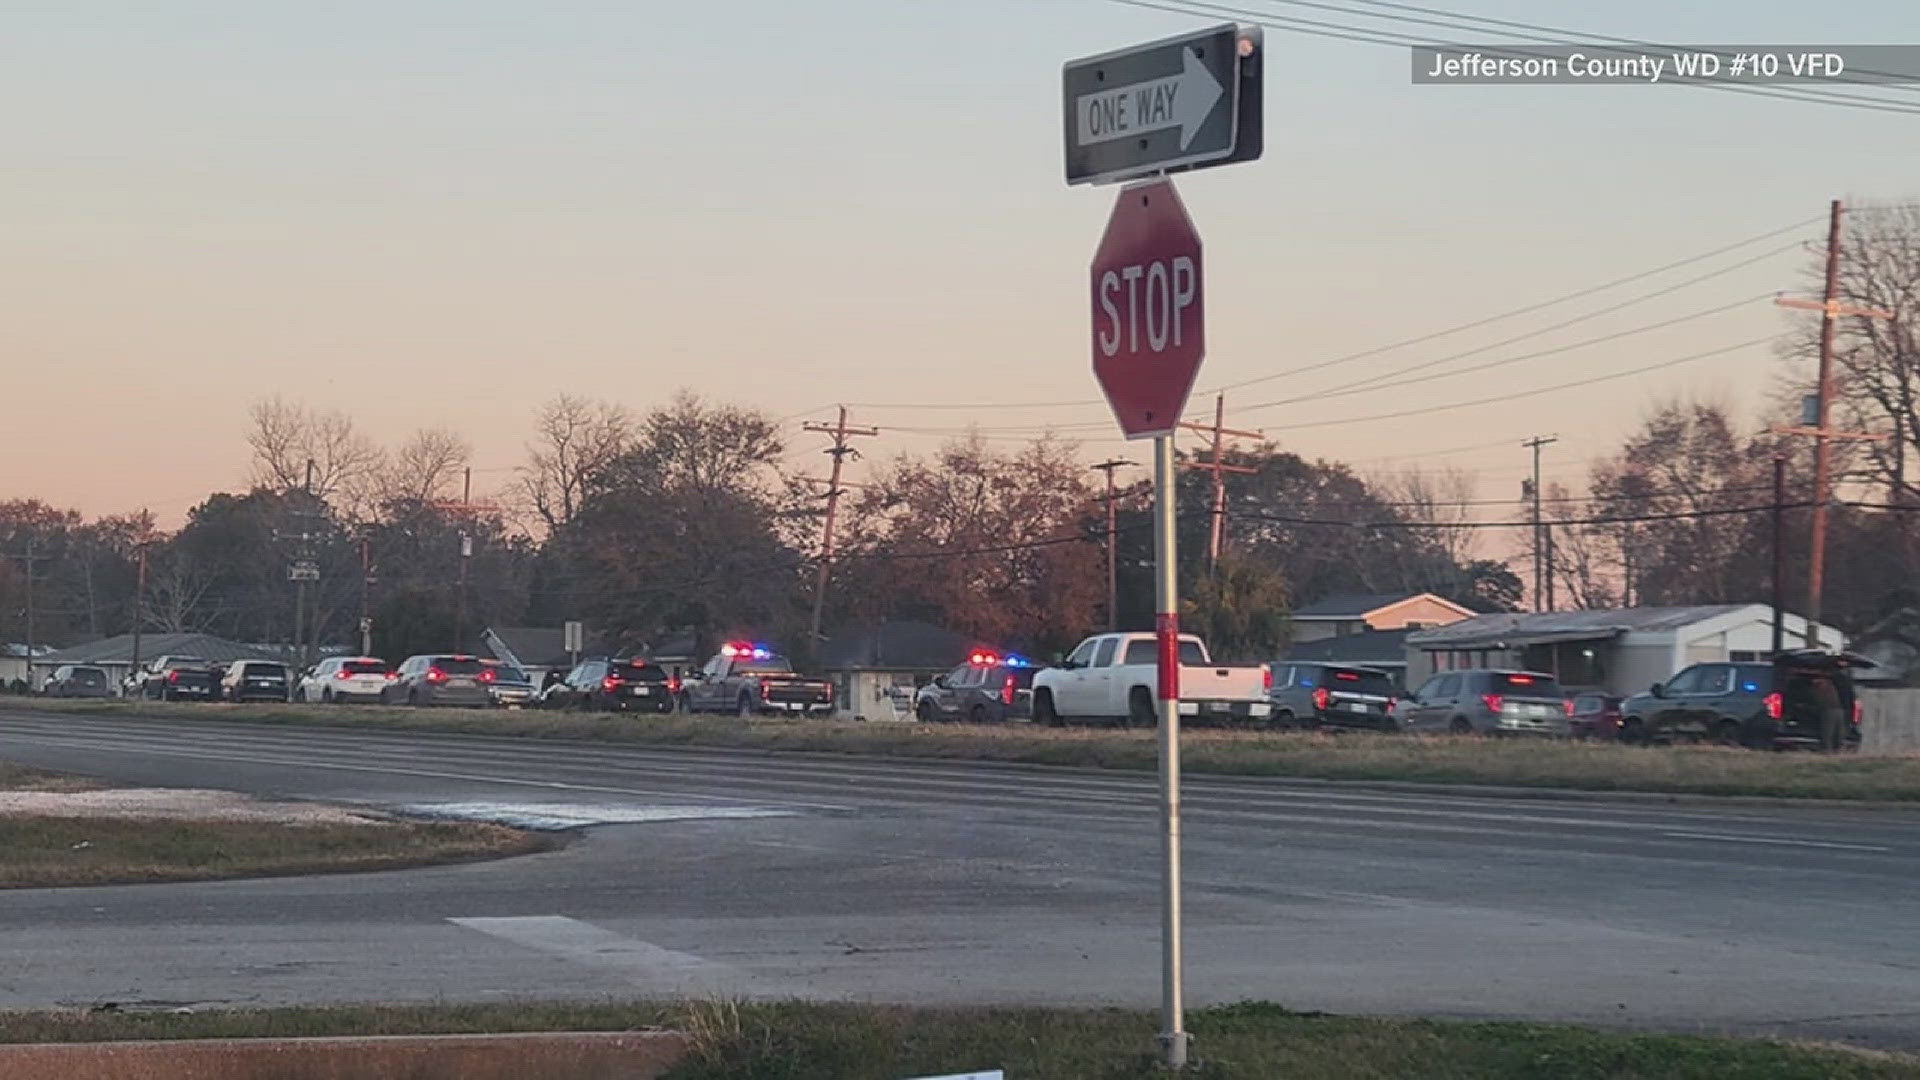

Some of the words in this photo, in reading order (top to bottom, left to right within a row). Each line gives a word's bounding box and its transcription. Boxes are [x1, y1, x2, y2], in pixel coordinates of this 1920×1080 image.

[1089, 95, 1127, 135] ONE
[1137, 84, 1178, 125] WAY
[1100, 256, 1195, 356] STOP
